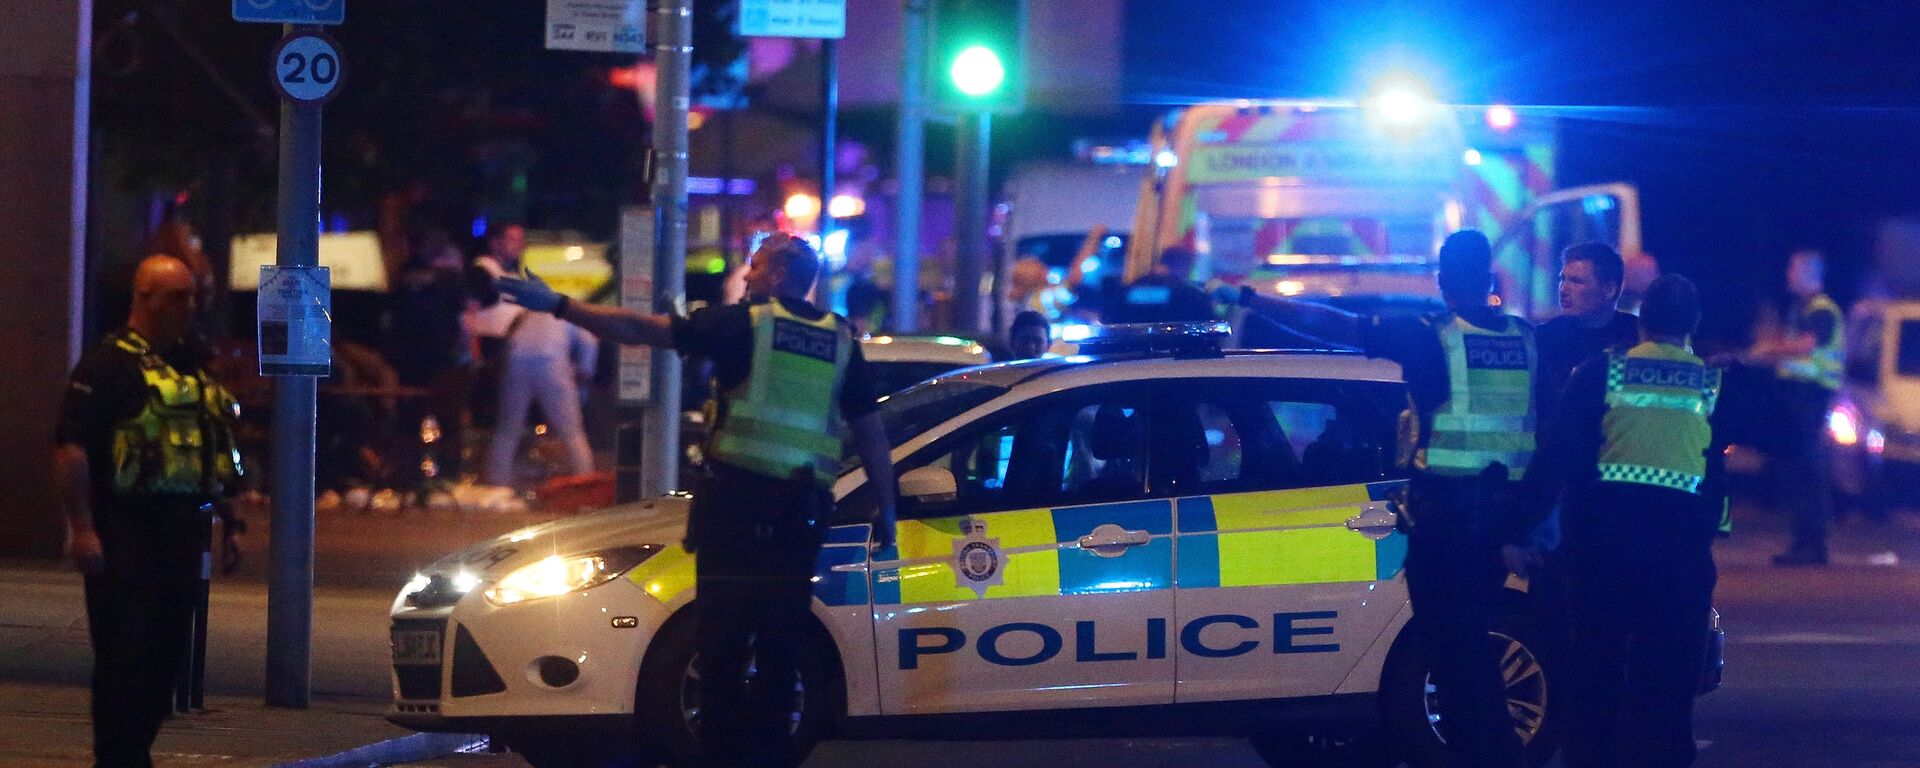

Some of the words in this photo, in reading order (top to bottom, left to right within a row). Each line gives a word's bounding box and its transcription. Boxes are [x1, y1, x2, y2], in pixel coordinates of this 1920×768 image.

[283, 52, 336, 84] 20
[777, 332, 834, 360] POLICE
[1469, 349, 1525, 366] POLICE
[1627, 367, 1699, 388] POLICE
[899, 610, 1341, 670] POLICE
